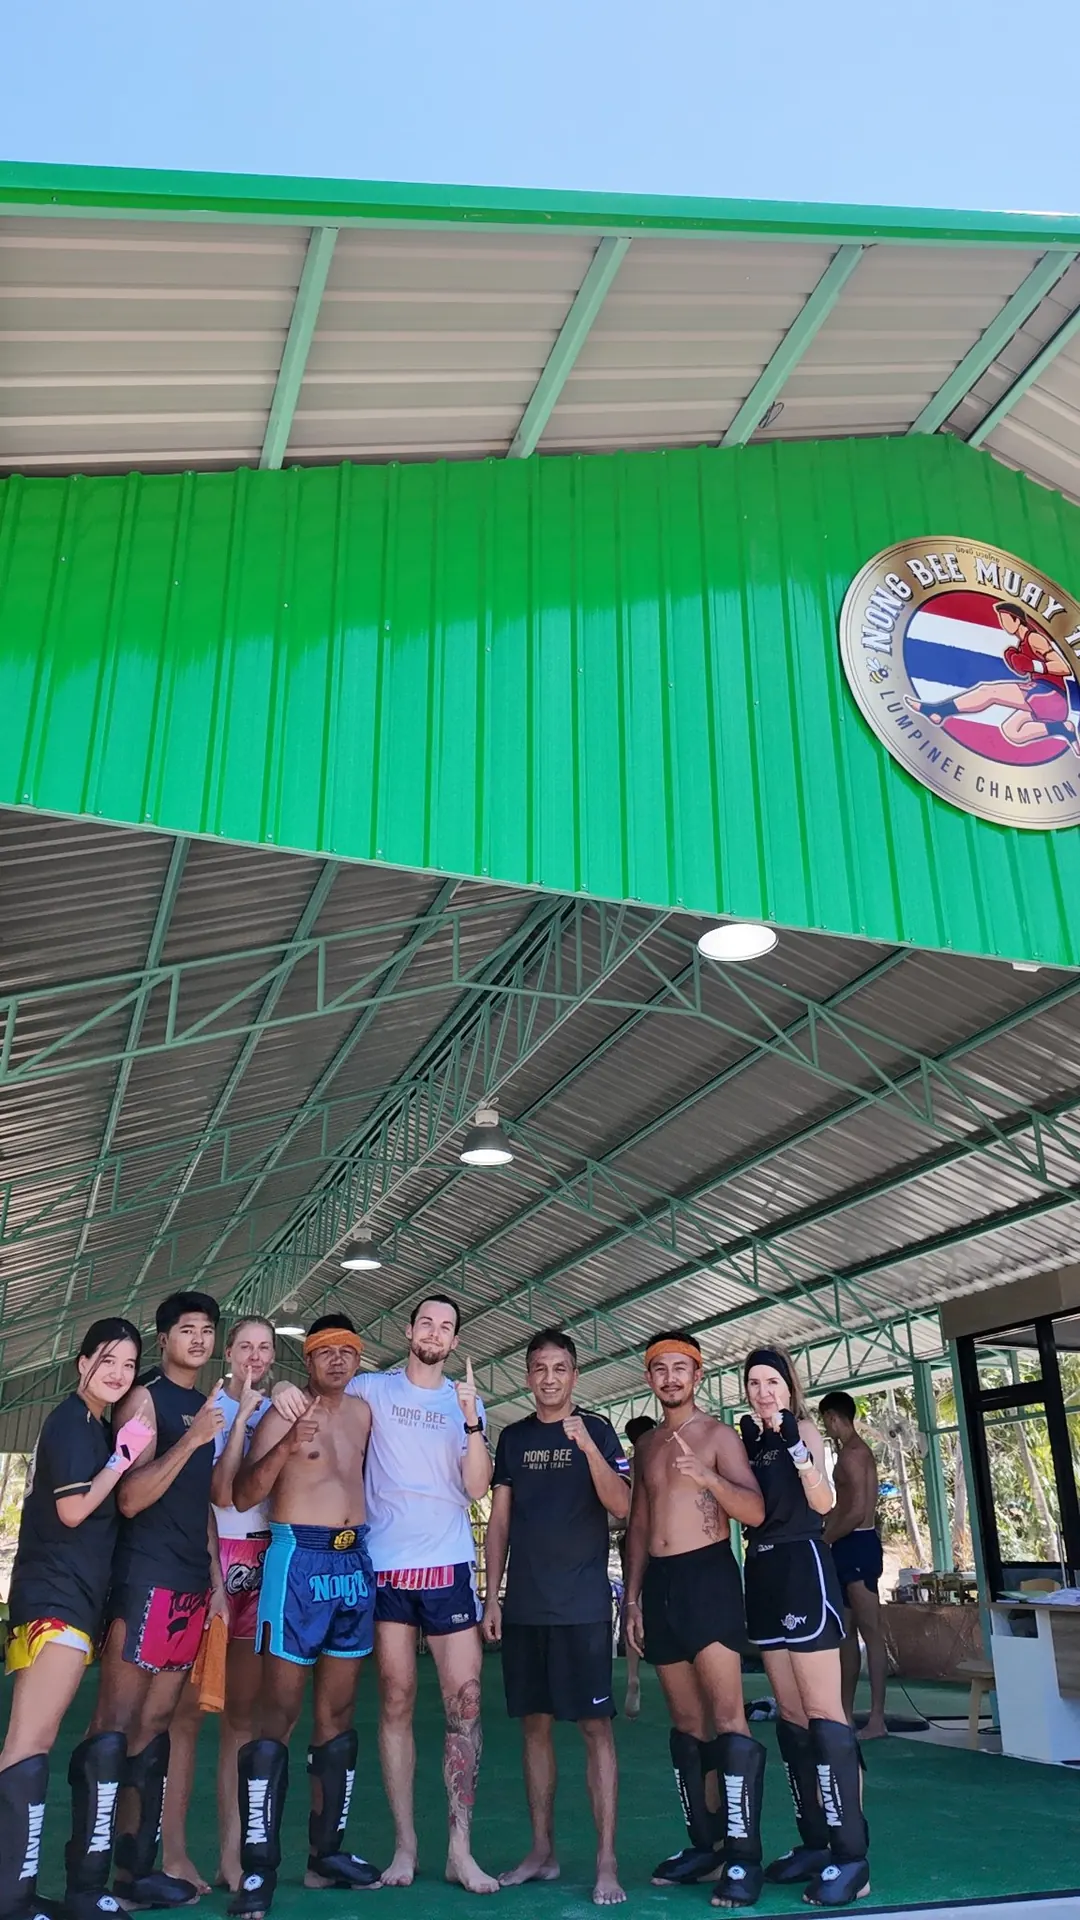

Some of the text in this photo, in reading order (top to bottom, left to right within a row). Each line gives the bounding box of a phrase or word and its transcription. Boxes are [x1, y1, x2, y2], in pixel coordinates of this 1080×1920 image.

[861, 553, 1067, 656] NONG BEE MUAY
[879, 690, 1077, 805] LUMPINEE CHAMPION
[391, 1403, 447, 1425] NONG BEE
[397, 1418, 439, 1430] MUAY THAI
[523, 1448, 573, 1463] NONG BEE
[528, 1461, 565, 1470] MUAY THAI
[87, 1781, 119, 1855] MAVINN
[245, 1777, 268, 1845] MAVINN
[723, 1773, 749, 1839] MAVINN
[816, 1763, 843, 1827] MAVINN
[18, 1802, 46, 1881] MAVINN
